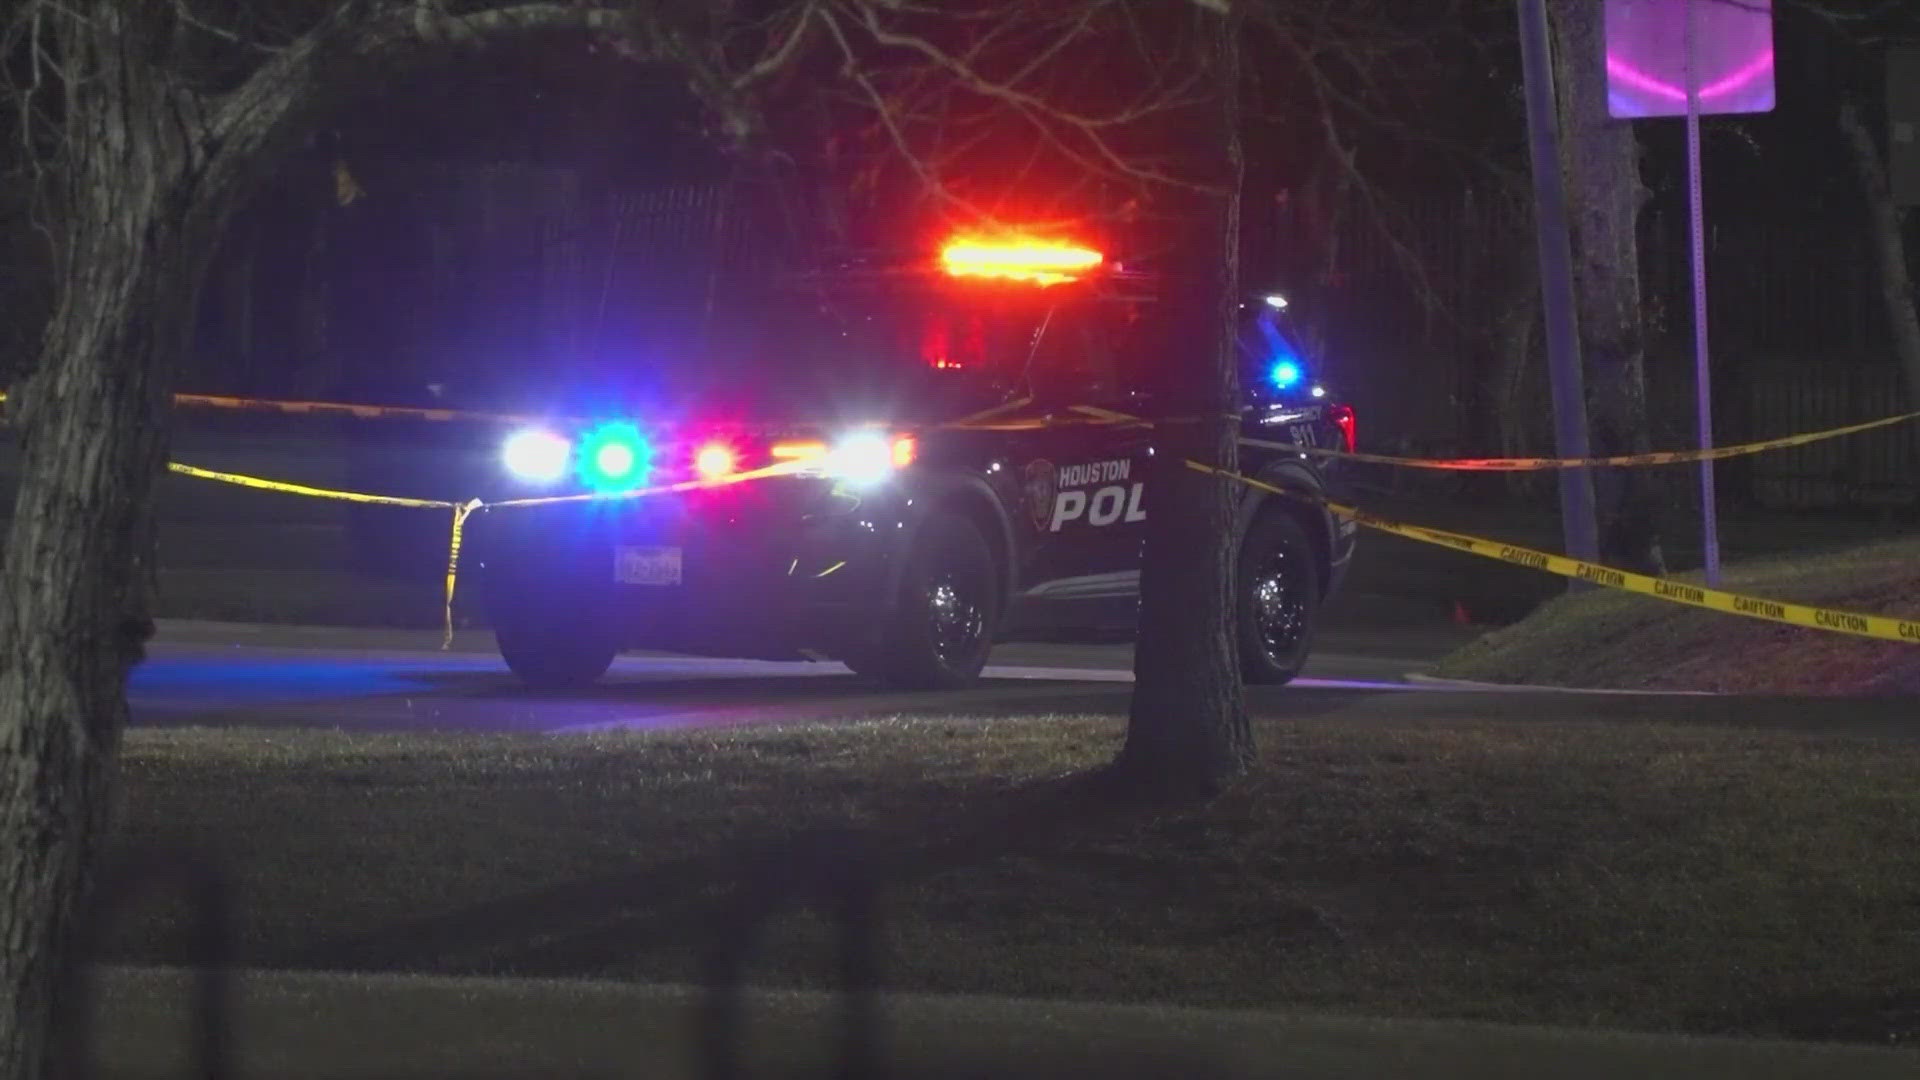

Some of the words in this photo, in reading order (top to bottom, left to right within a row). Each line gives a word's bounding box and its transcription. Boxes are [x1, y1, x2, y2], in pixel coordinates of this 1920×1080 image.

[1059, 459, 1130, 489] HOUSTON
[1049, 482, 1147, 532] POL
[1576, 563, 1625, 586] CAUTION
[1654, 580, 1704, 602] CAUTION
[1733, 597, 1785, 618] CAUTION
[1815, 611, 1868, 632] CAUTION
